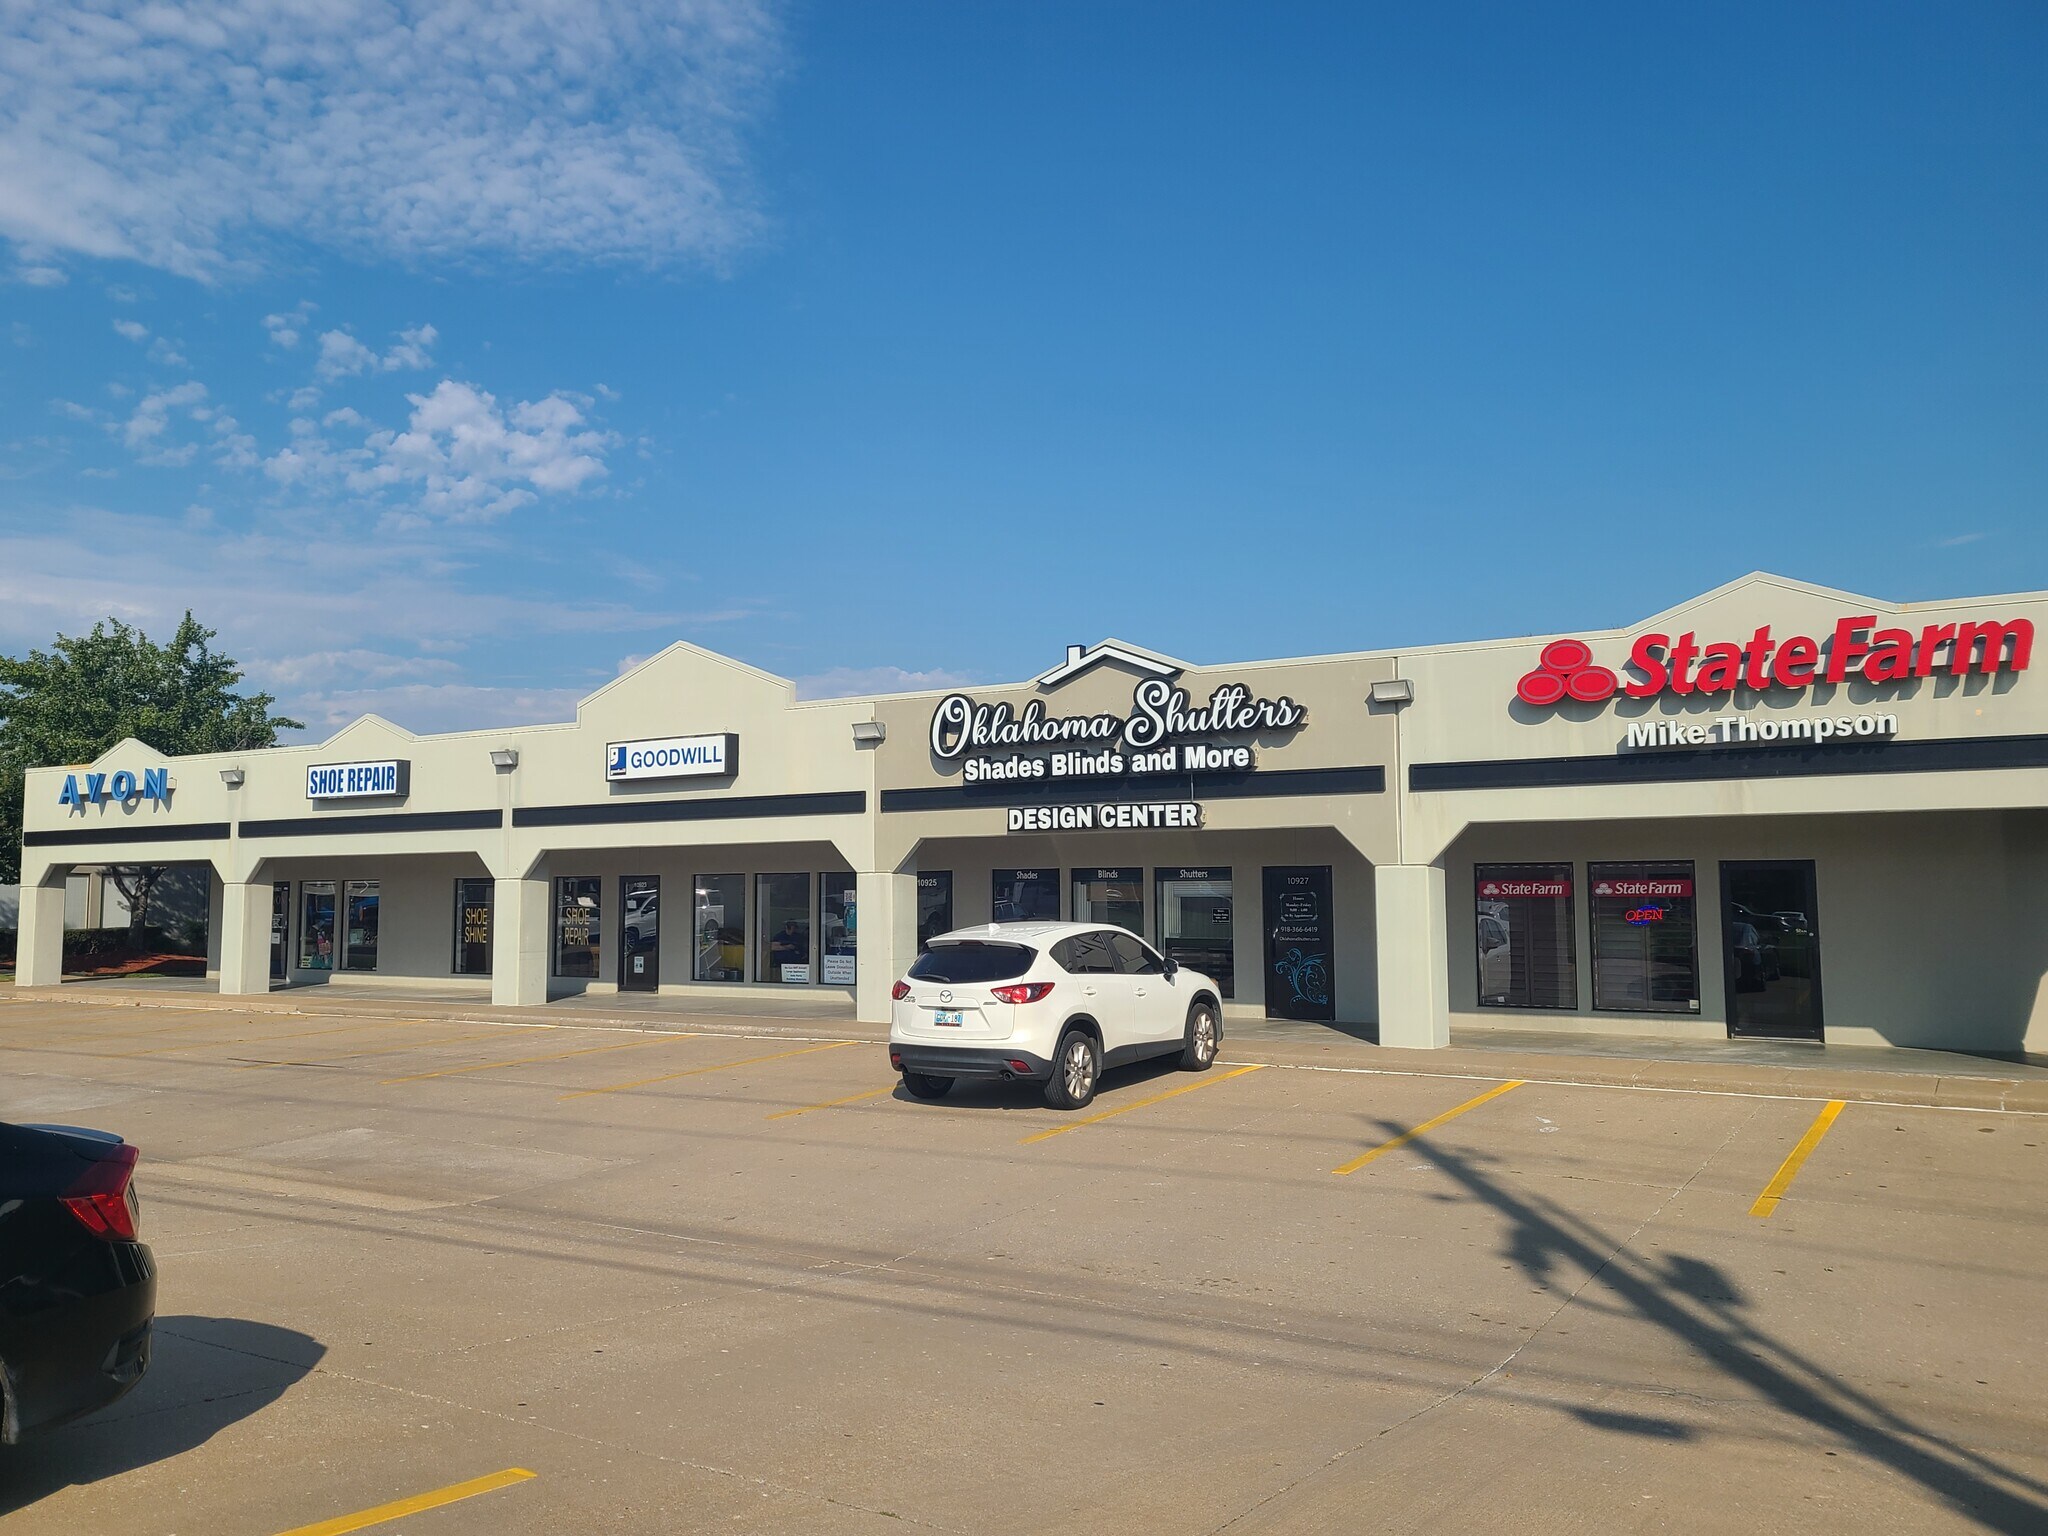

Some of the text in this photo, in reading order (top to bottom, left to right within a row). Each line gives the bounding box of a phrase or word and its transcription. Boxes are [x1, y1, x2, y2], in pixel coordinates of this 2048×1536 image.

[931, 677, 1301, 758] Oklahoma Shutters
[1627, 712, 1898, 748] Mike Thompson
[631, 746, 722, 769] GOODWILL
[964, 745, 1249, 782] Shades Blinds and More
[58, 768, 169, 805] AVON
[310, 765, 395, 795] SHOE REPAIR
[1008, 804, 1198, 832] DESIGN CENTER
[917, 878, 938, 887] 10925
[1016, 870, 1038, 880] Shades
[1098, 869, 1118, 879] Blinds
[1180, 869, 1208, 879] Shutters
[1287, 877, 1309, 885] 10927
[465, 908, 488, 925] SHOE
[565, 907, 590, 925] SHOE
[1625, 908, 1663, 922] OPEN
[464, 926, 487, 943] SHINE
[564, 927, 589, 946] REPAIR
